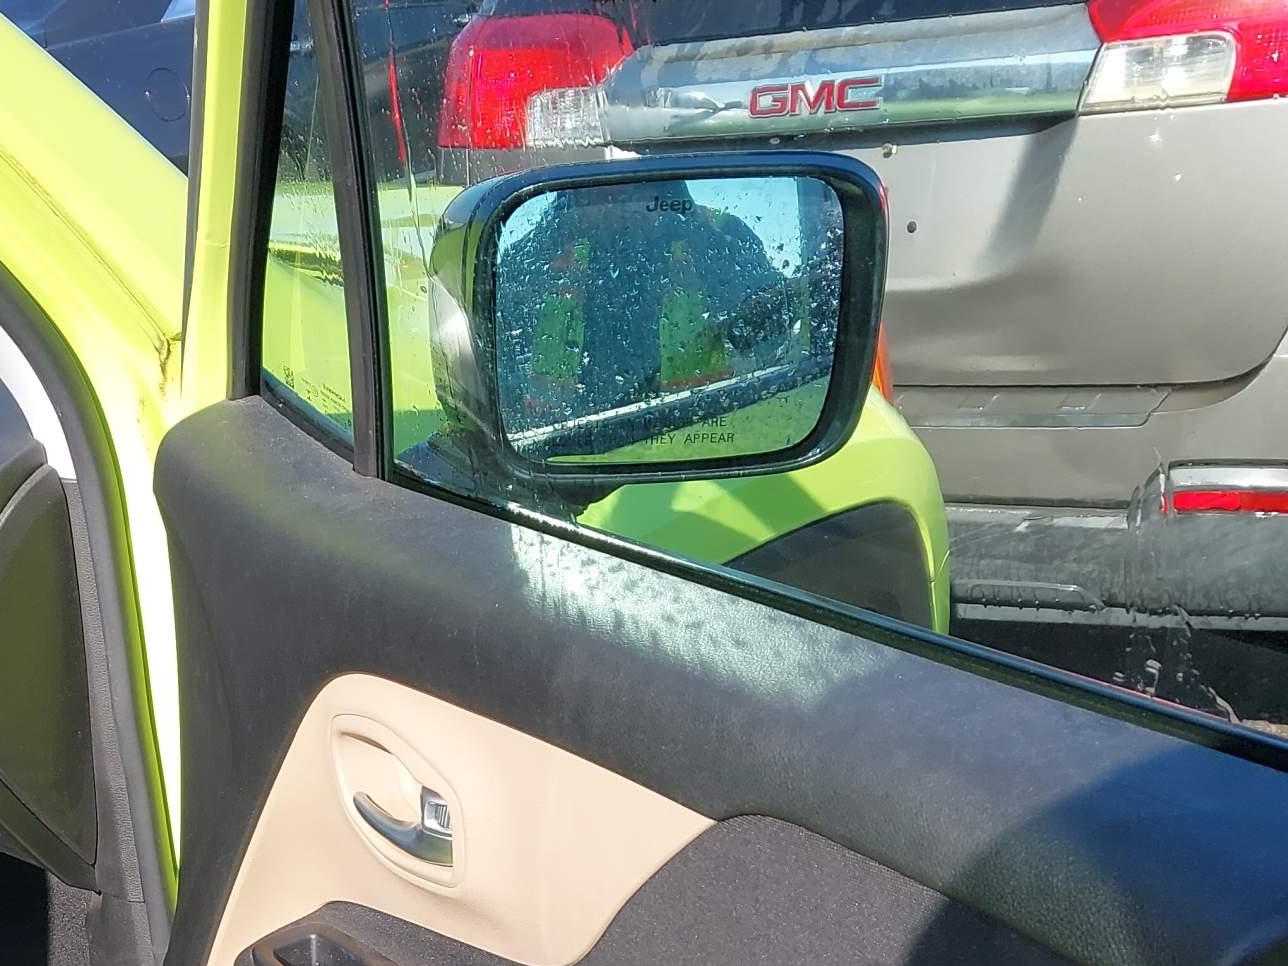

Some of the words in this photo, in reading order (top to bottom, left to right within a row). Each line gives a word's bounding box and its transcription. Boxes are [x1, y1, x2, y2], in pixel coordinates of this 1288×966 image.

[749, 76, 883, 118] GMC
[646, 196, 692, 217] Jeep
[701, 416, 728, 428] ARE
[683, 432, 735, 445] APPEAR
